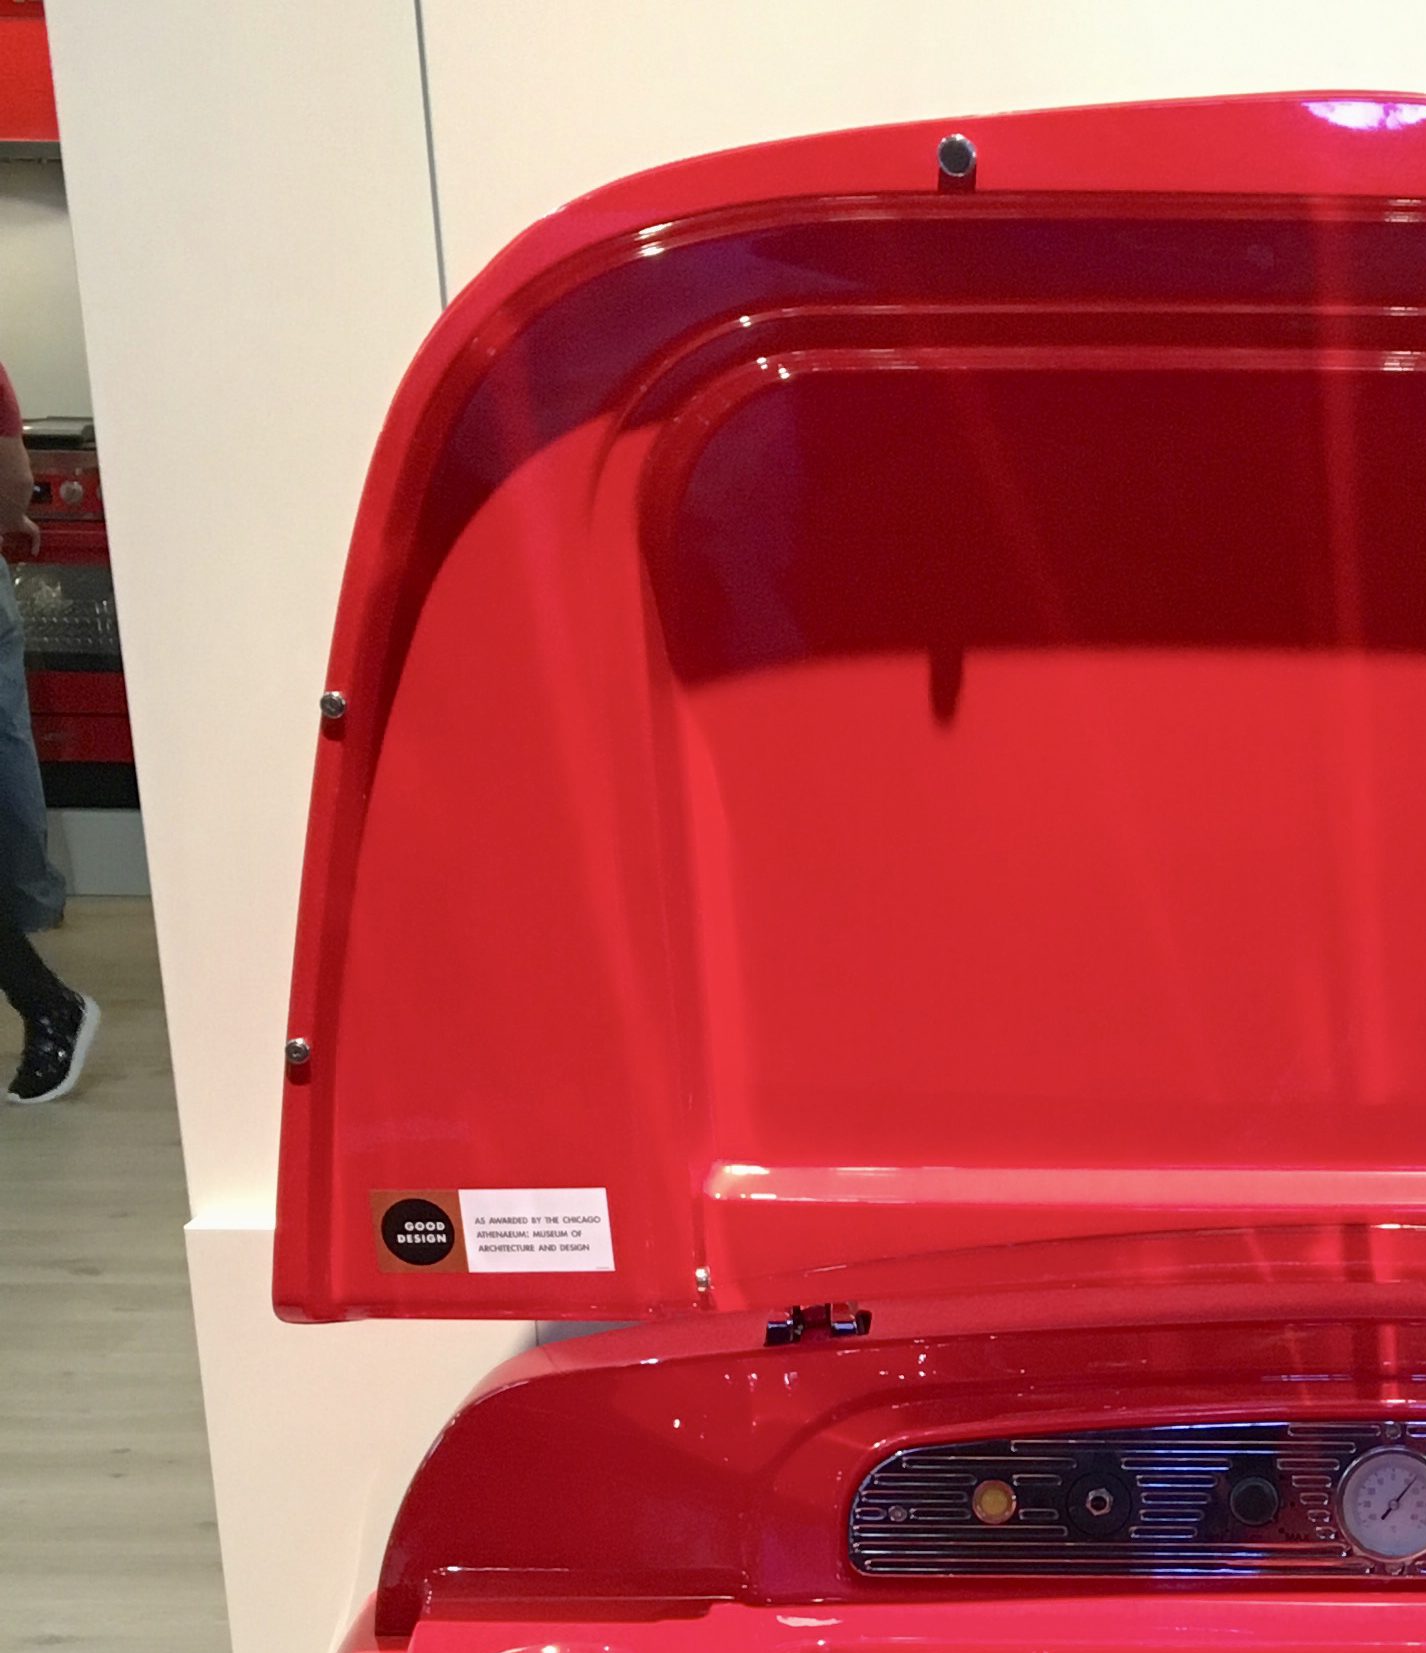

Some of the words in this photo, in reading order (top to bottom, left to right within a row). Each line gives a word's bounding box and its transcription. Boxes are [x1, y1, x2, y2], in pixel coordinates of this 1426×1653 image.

[475, 1217, 485, 1225] AS
[532, 1216, 541, 1224] BY
[544, 1216, 559, 1224] THE
[563, 1216, 601, 1224] CHICAGO
[404, 1221, 446, 1232] GOOD
[397, 1233, 447, 1244] DESIGN
[477, 1230, 529, 1238] ATHENAEUM:
[533, 1230, 568, 1238] MUSEUM
[571, 1230, 582, 1238] OF
[478, 1244, 535, 1252] ARCHITECTURE
[538, 1244, 556, 1252] AND
[560, 1244, 590, 1252] DESIGN
